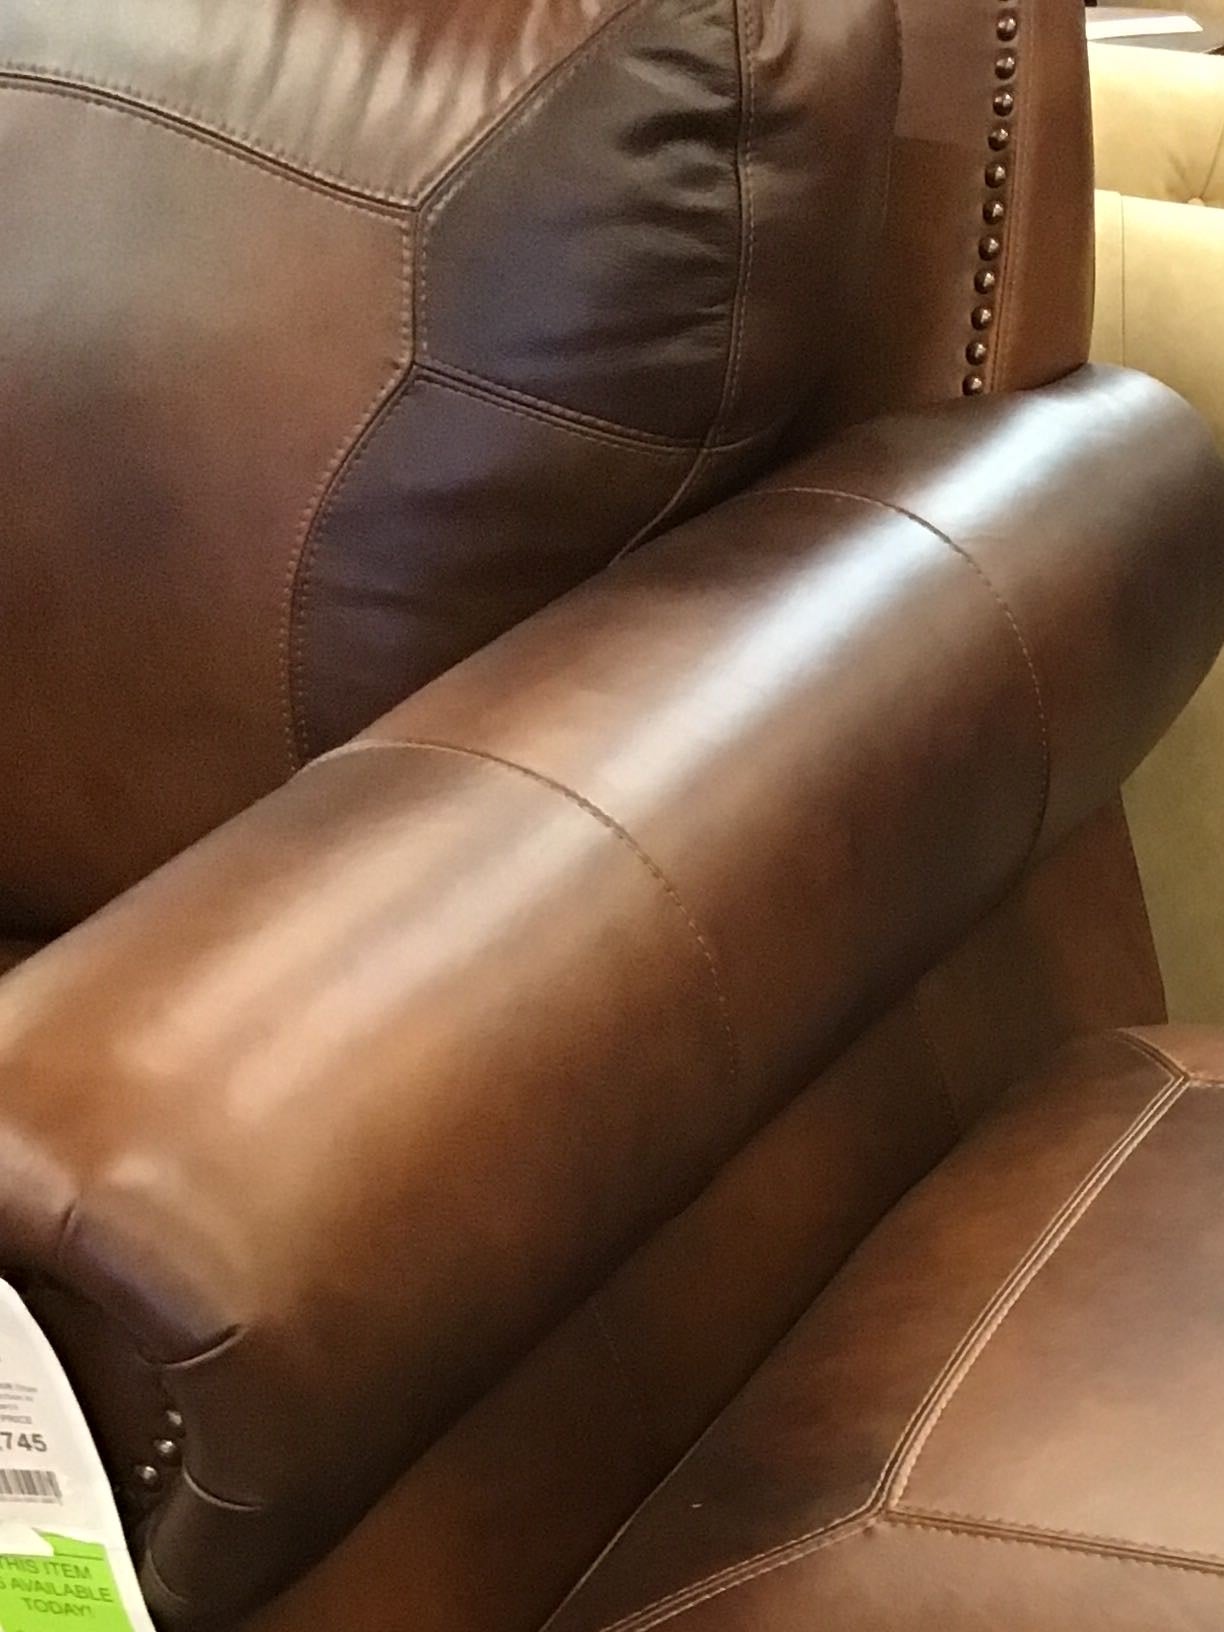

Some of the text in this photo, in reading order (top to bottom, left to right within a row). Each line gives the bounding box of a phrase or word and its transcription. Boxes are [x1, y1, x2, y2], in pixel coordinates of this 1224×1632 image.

[0, 1431, 48, 1452] 745
[43, 1561, 93, 1579] ITEM
[11, 1577, 114, 1603] AVAILABLE
